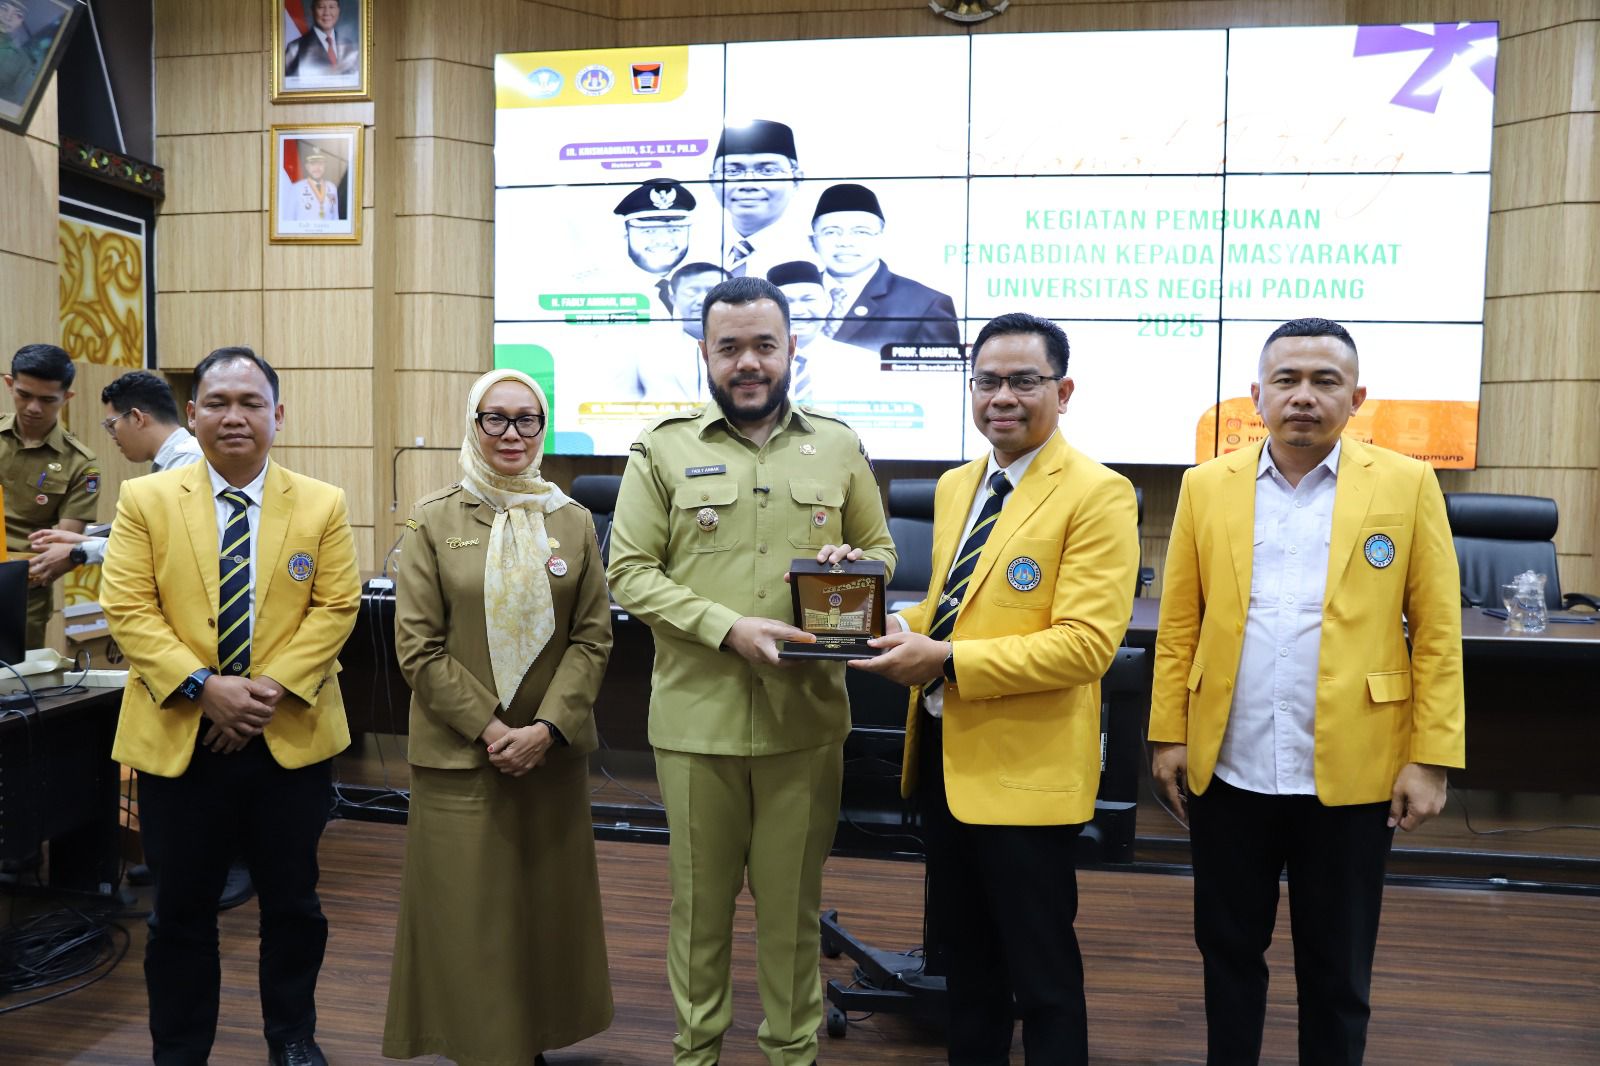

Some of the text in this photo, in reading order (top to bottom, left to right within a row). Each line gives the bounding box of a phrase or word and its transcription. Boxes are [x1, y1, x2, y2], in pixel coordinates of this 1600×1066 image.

[1025, 208, 1321, 230] KEGIATAN PEMBUKAAN
[944, 243, 1402, 265] PENGABDIAN KEPADA MASYARAKAT
[987, 277, 1365, 299] UNIVERSITAS NEGERI PADANG
[1137, 312, 1204, 337] 2025
